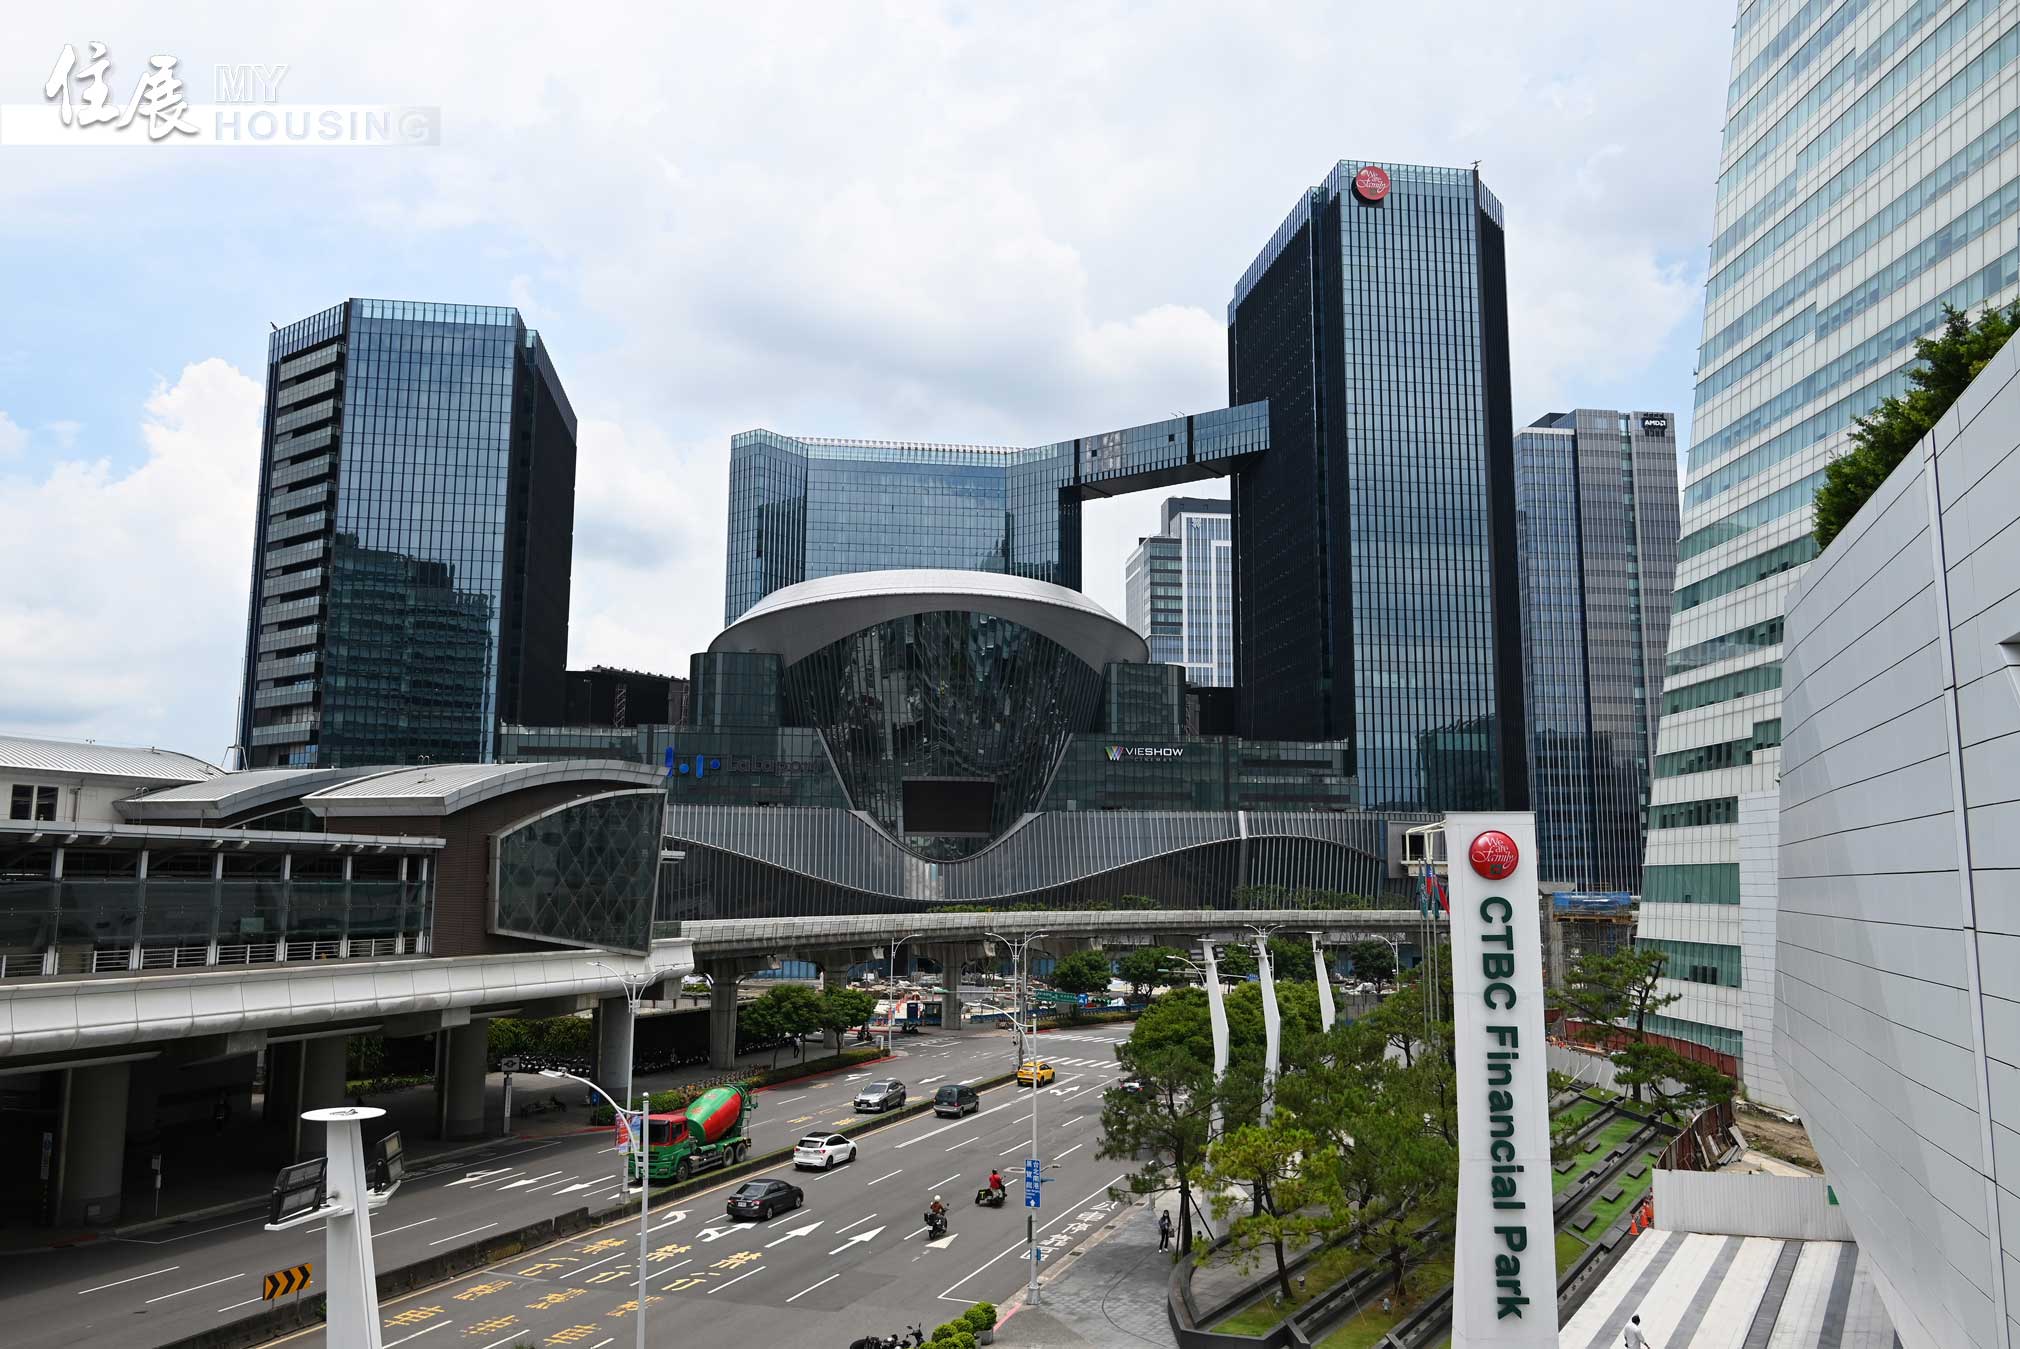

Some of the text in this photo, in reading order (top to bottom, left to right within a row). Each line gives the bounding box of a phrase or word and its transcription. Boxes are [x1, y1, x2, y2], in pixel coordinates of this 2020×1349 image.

[1126, 747, 1183, 756] VIESHOW
[1484, 836, 1504, 847] We
[1495, 844, 1509, 853] are
[1472, 846, 1514, 870] Family
[1480, 896, 1530, 1320] CTBC Financial Park
